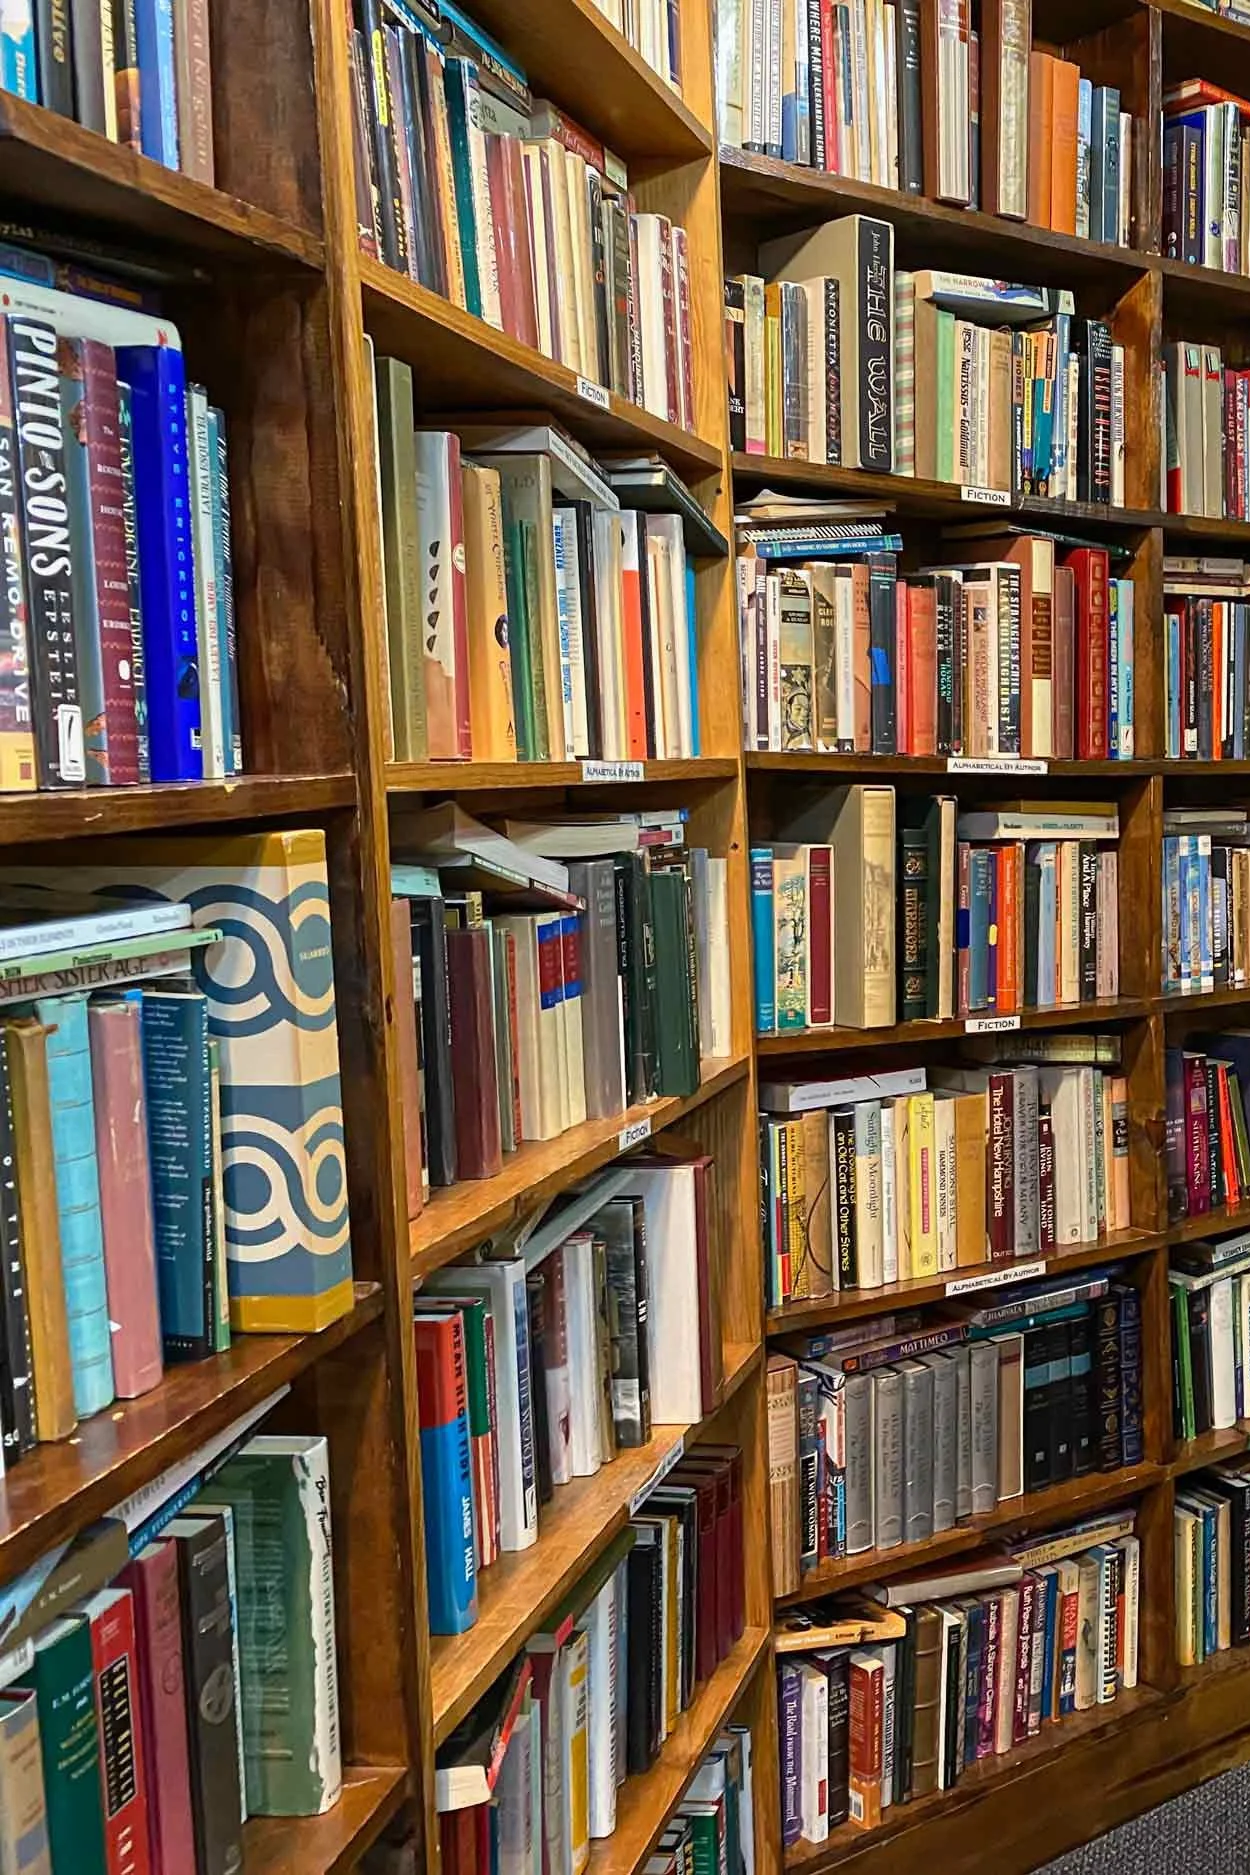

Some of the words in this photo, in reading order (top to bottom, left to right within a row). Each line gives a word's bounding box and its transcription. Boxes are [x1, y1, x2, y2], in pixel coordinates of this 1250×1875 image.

[808, 1, 821, 42] WHERE
[811, 47, 823, 72] MAN
[867, 265, 888, 342] THE
[14, 322, 63, 451] PINTO
[581, 382, 606, 404] FICTION
[959, 357, 970, 406] Narcissus
[865, 356, 887, 460] WALL
[168, 384, 182, 475] STEVE
[176, 497, 190, 642] ERICKSON
[966, 490, 1006, 503] FICTION
[24, 466, 72, 577] SONS
[999, 578, 1010, 612] ALAN
[1009, 575, 1020, 592] THE
[61, 592, 77, 700] LESLIE
[1009, 661, 1020, 695] CHILD
[952, 761, 1004, 772] ALPHABETICAL
[54, 965, 104, 989] SISTER
[108, 957, 150, 979] AGE
[625, 1124, 649, 1144] FICTION
[992, 1161, 1003, 1217] Hampshire
[838, 1237, 849, 1271] Stories
[952, 1277, 1002, 1293] ALPHABETICAL
[1014, 1267, 1041, 1278] AUTHOR
[452, 1323, 463, 1377] MEAN
[900, 1333, 948, 1355] MATTIMEO
[786, 1777, 797, 1822] Monument
